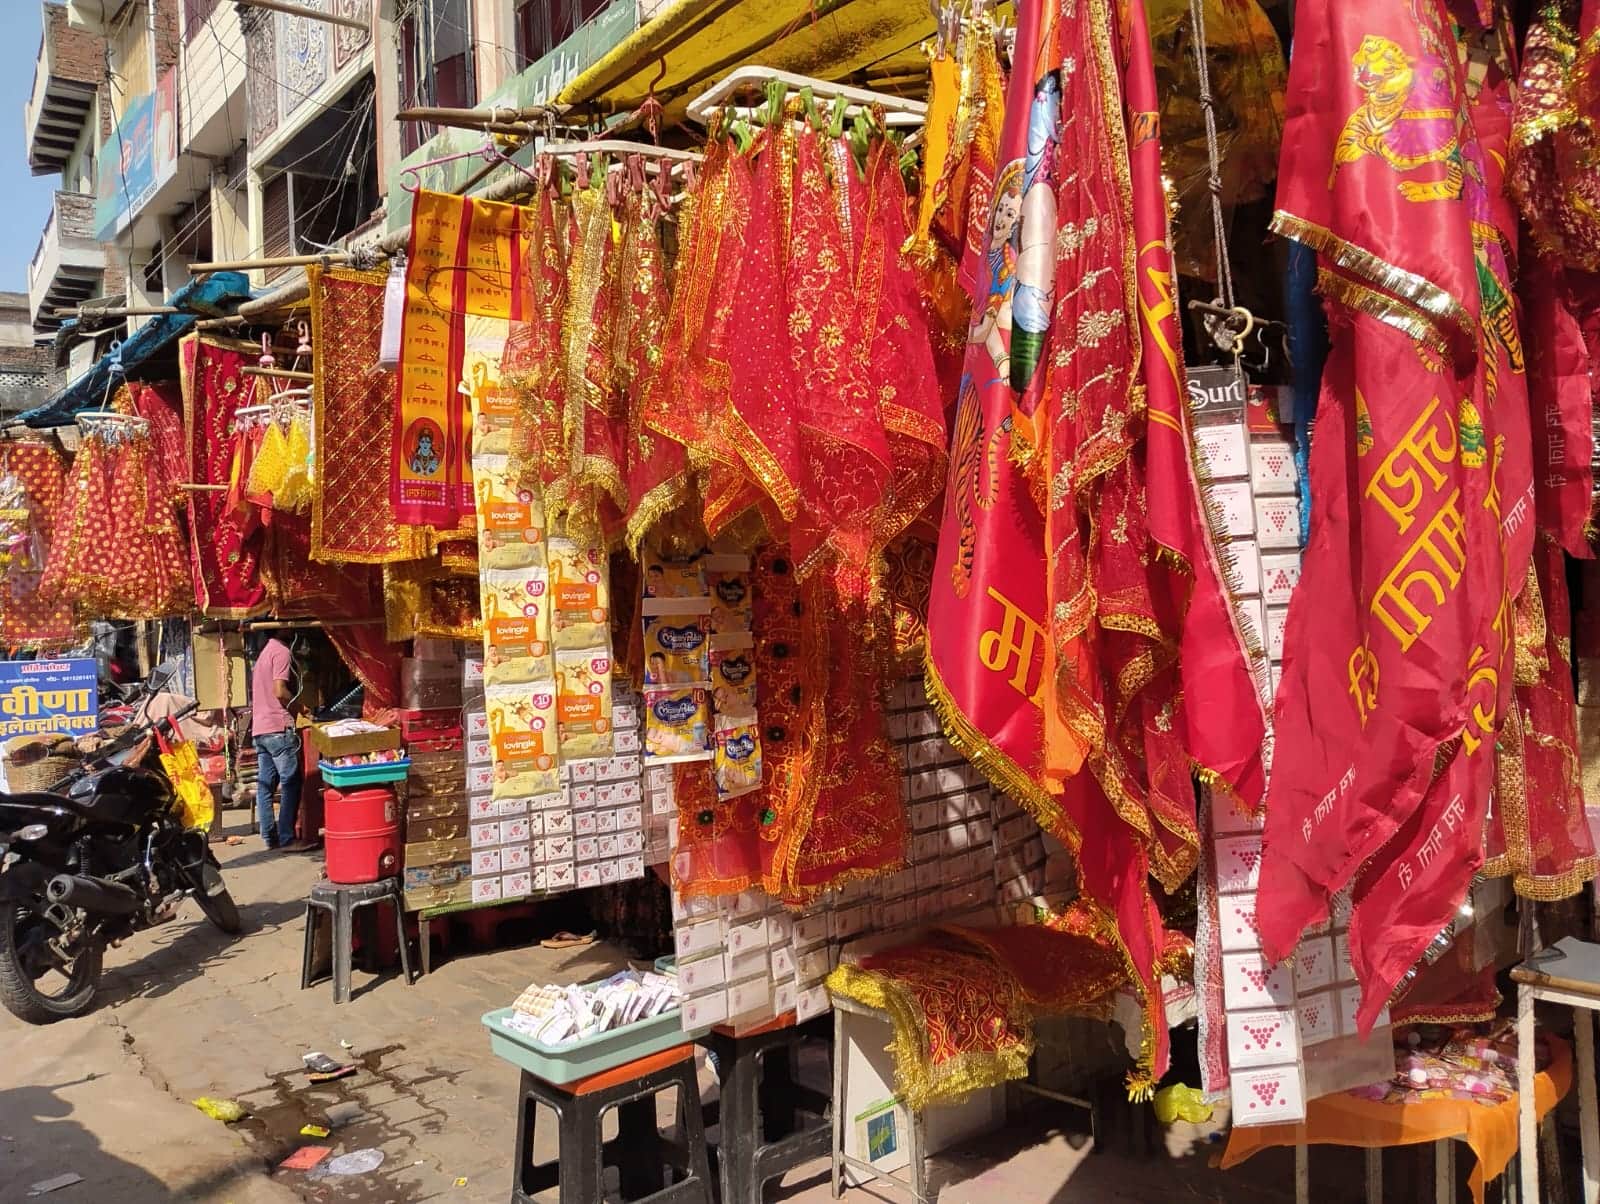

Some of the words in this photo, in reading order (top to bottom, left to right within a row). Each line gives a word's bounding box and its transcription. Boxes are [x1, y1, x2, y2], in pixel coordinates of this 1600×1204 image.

[491, 511, 524, 521] lovingle
[561, 591, 592, 601] lovingle
[496, 626, 529, 636] lovingle
[0, 686, 92, 715] वीणा
[564, 703, 596, 713] lovingle
[503, 740, 537, 750] lovingle
